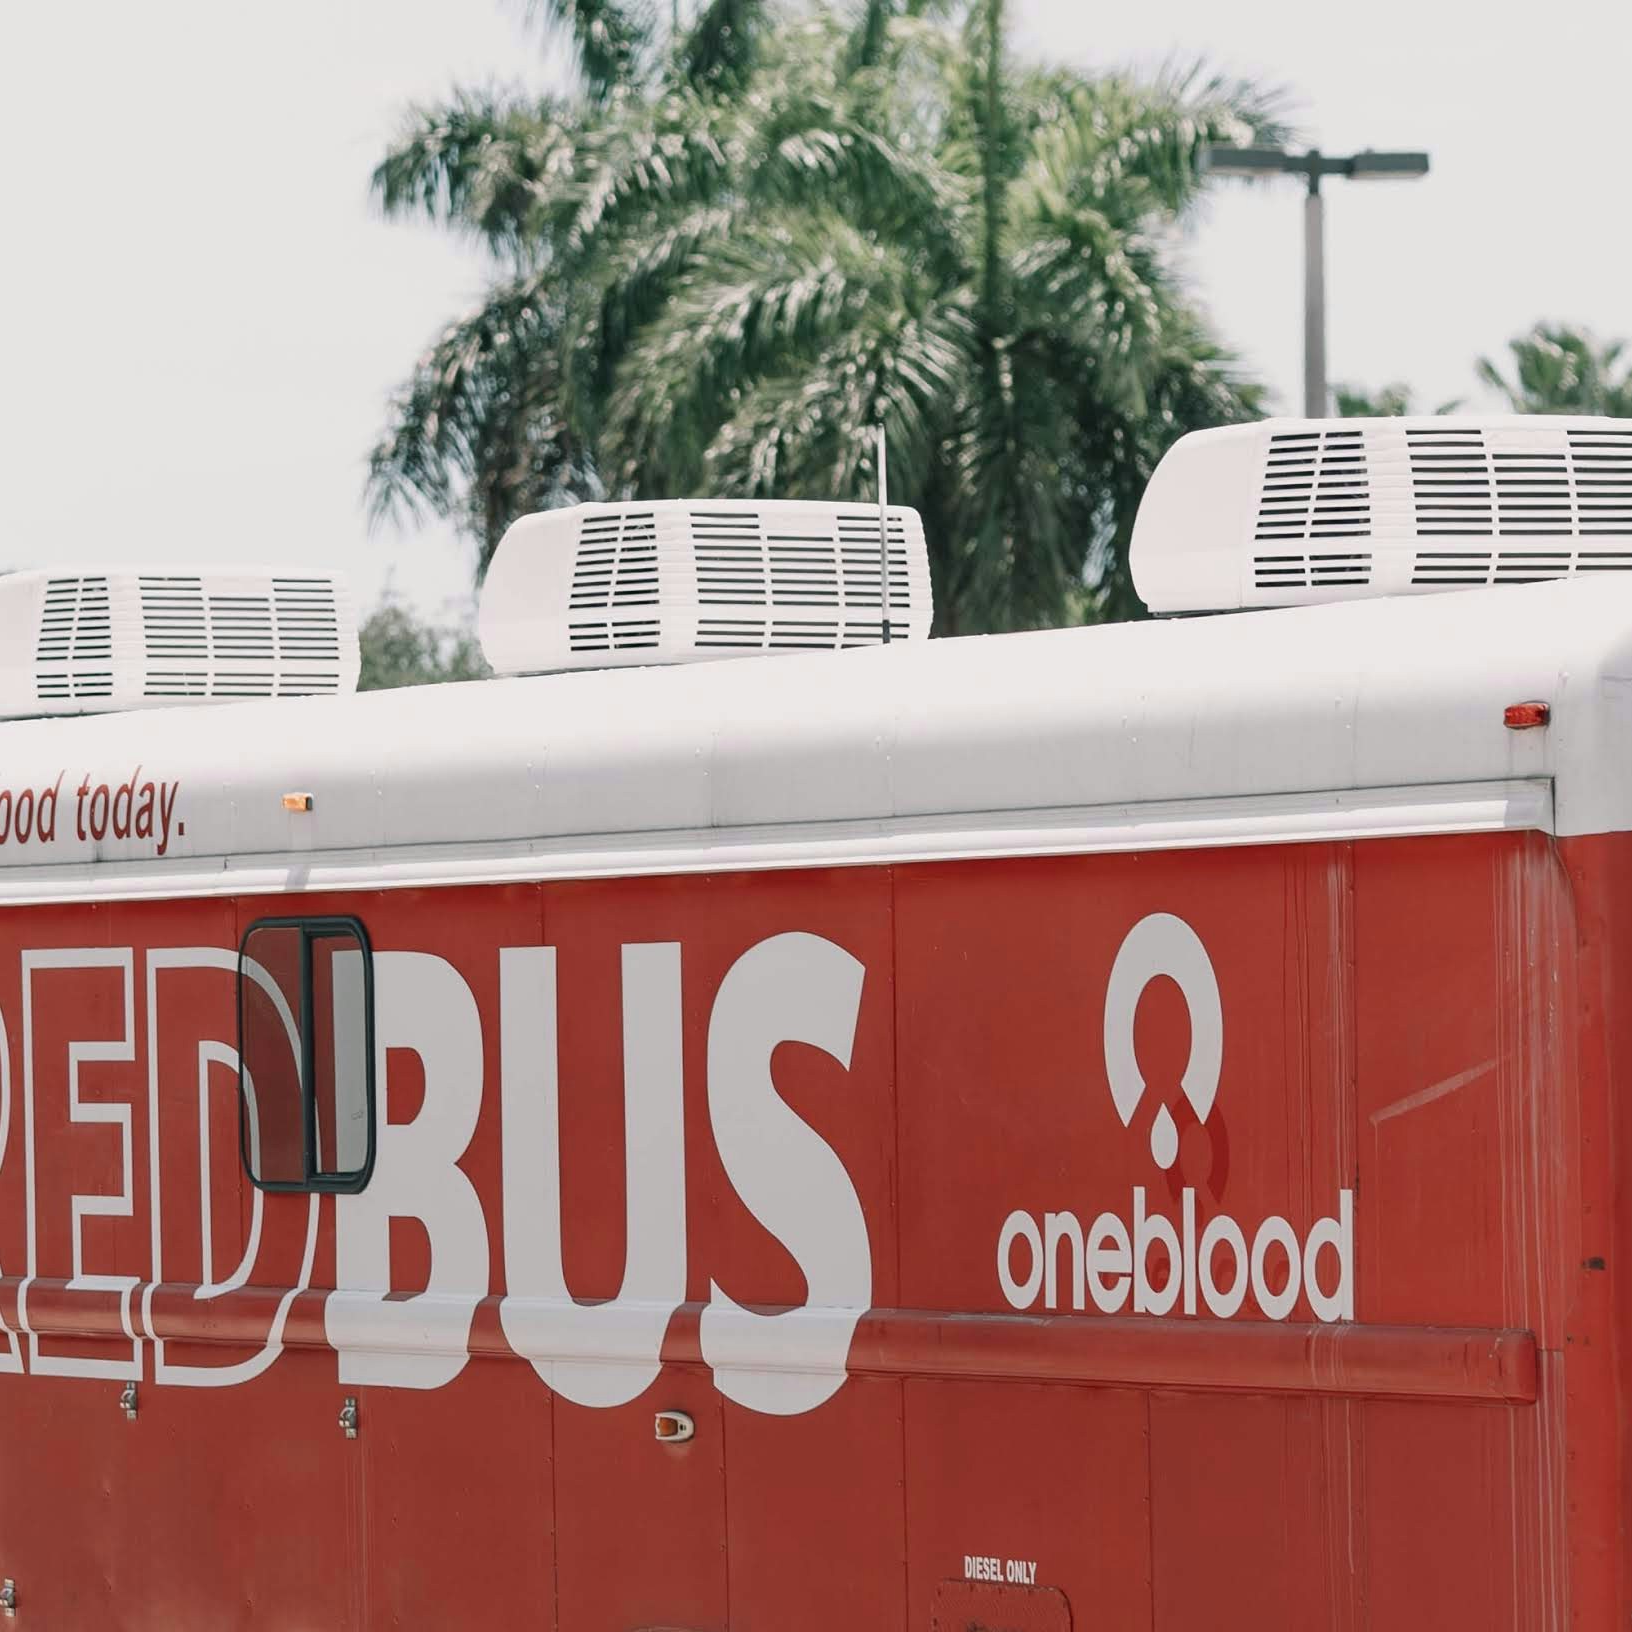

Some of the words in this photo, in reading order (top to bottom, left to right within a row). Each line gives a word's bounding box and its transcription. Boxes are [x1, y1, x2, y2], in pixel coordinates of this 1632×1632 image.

[76, 764, 185, 856] today.
[323, 930, 875, 1415] BUS
[997, 1186, 1354, 1323] oneblood
[964, 1555, 1004, 1582] DIESEL
[1006, 1559, 1037, 1585] ONLY
